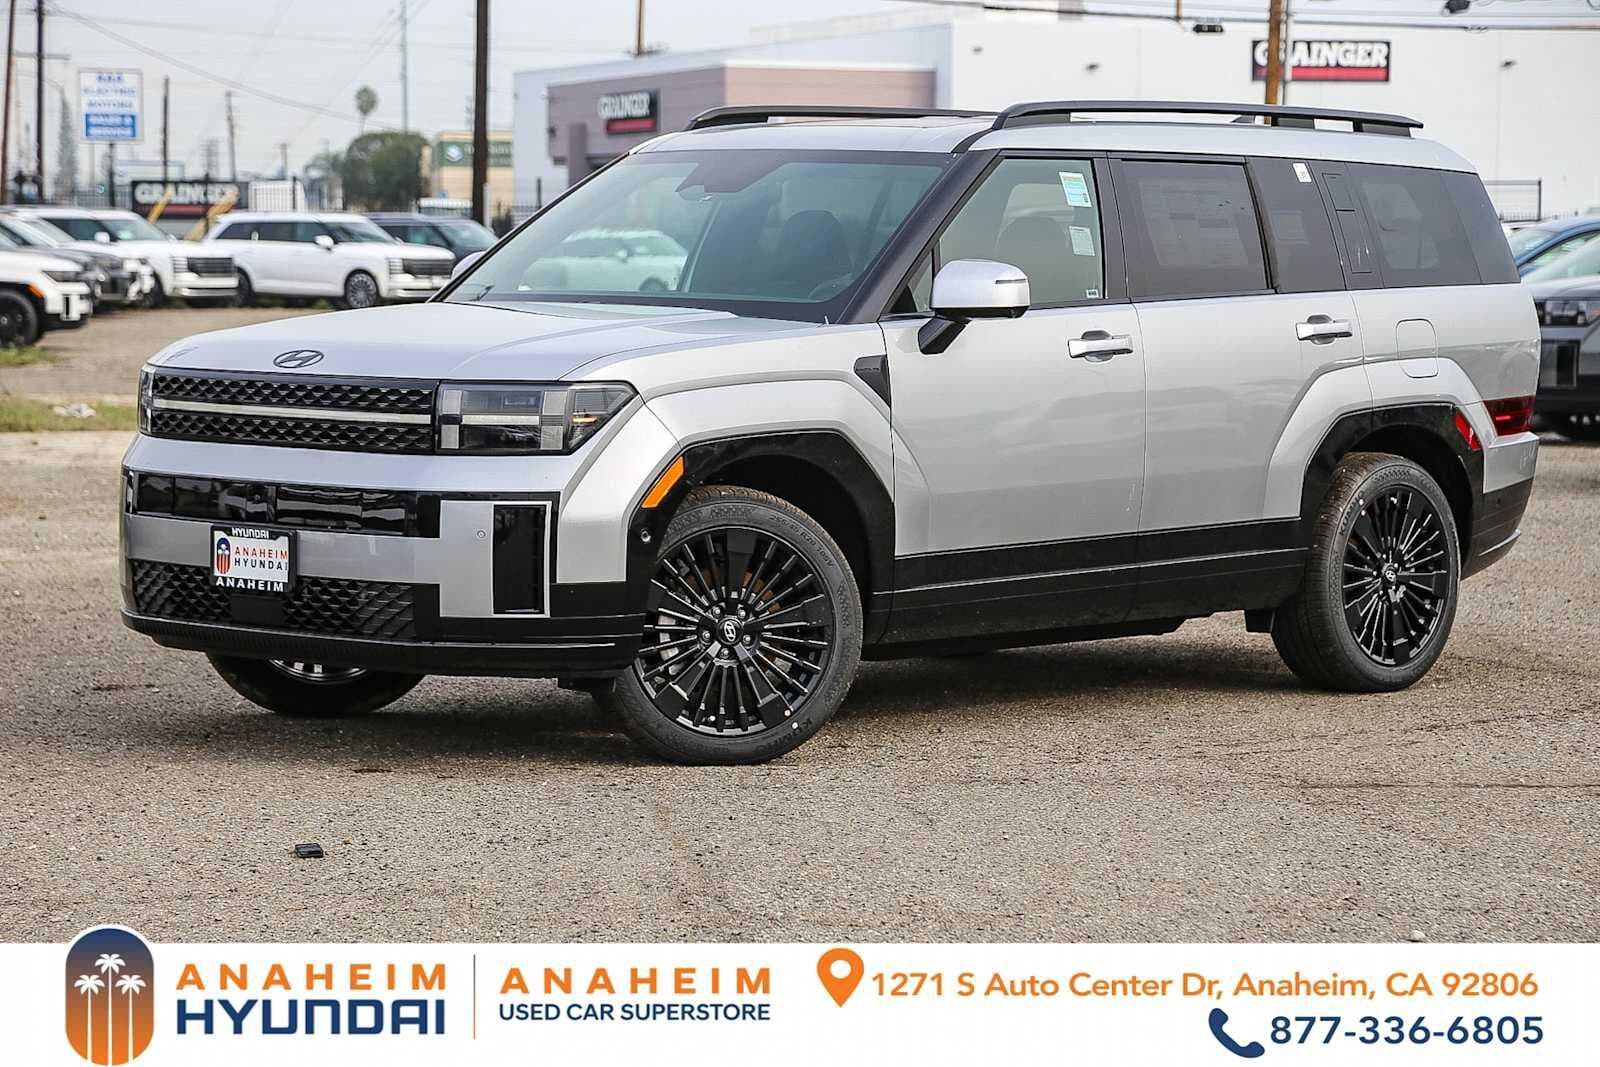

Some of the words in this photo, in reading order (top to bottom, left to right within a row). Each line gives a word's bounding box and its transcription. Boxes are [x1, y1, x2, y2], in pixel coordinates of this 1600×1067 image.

[1254, 40, 1389, 67] GAINGER
[231, 527, 270, 539] HYUNDAI
[234, 545, 288, 560] ANAHEIM
[233, 557, 288, 571] HYUNDAI
[215, 576, 284, 593] ANAHEIM
